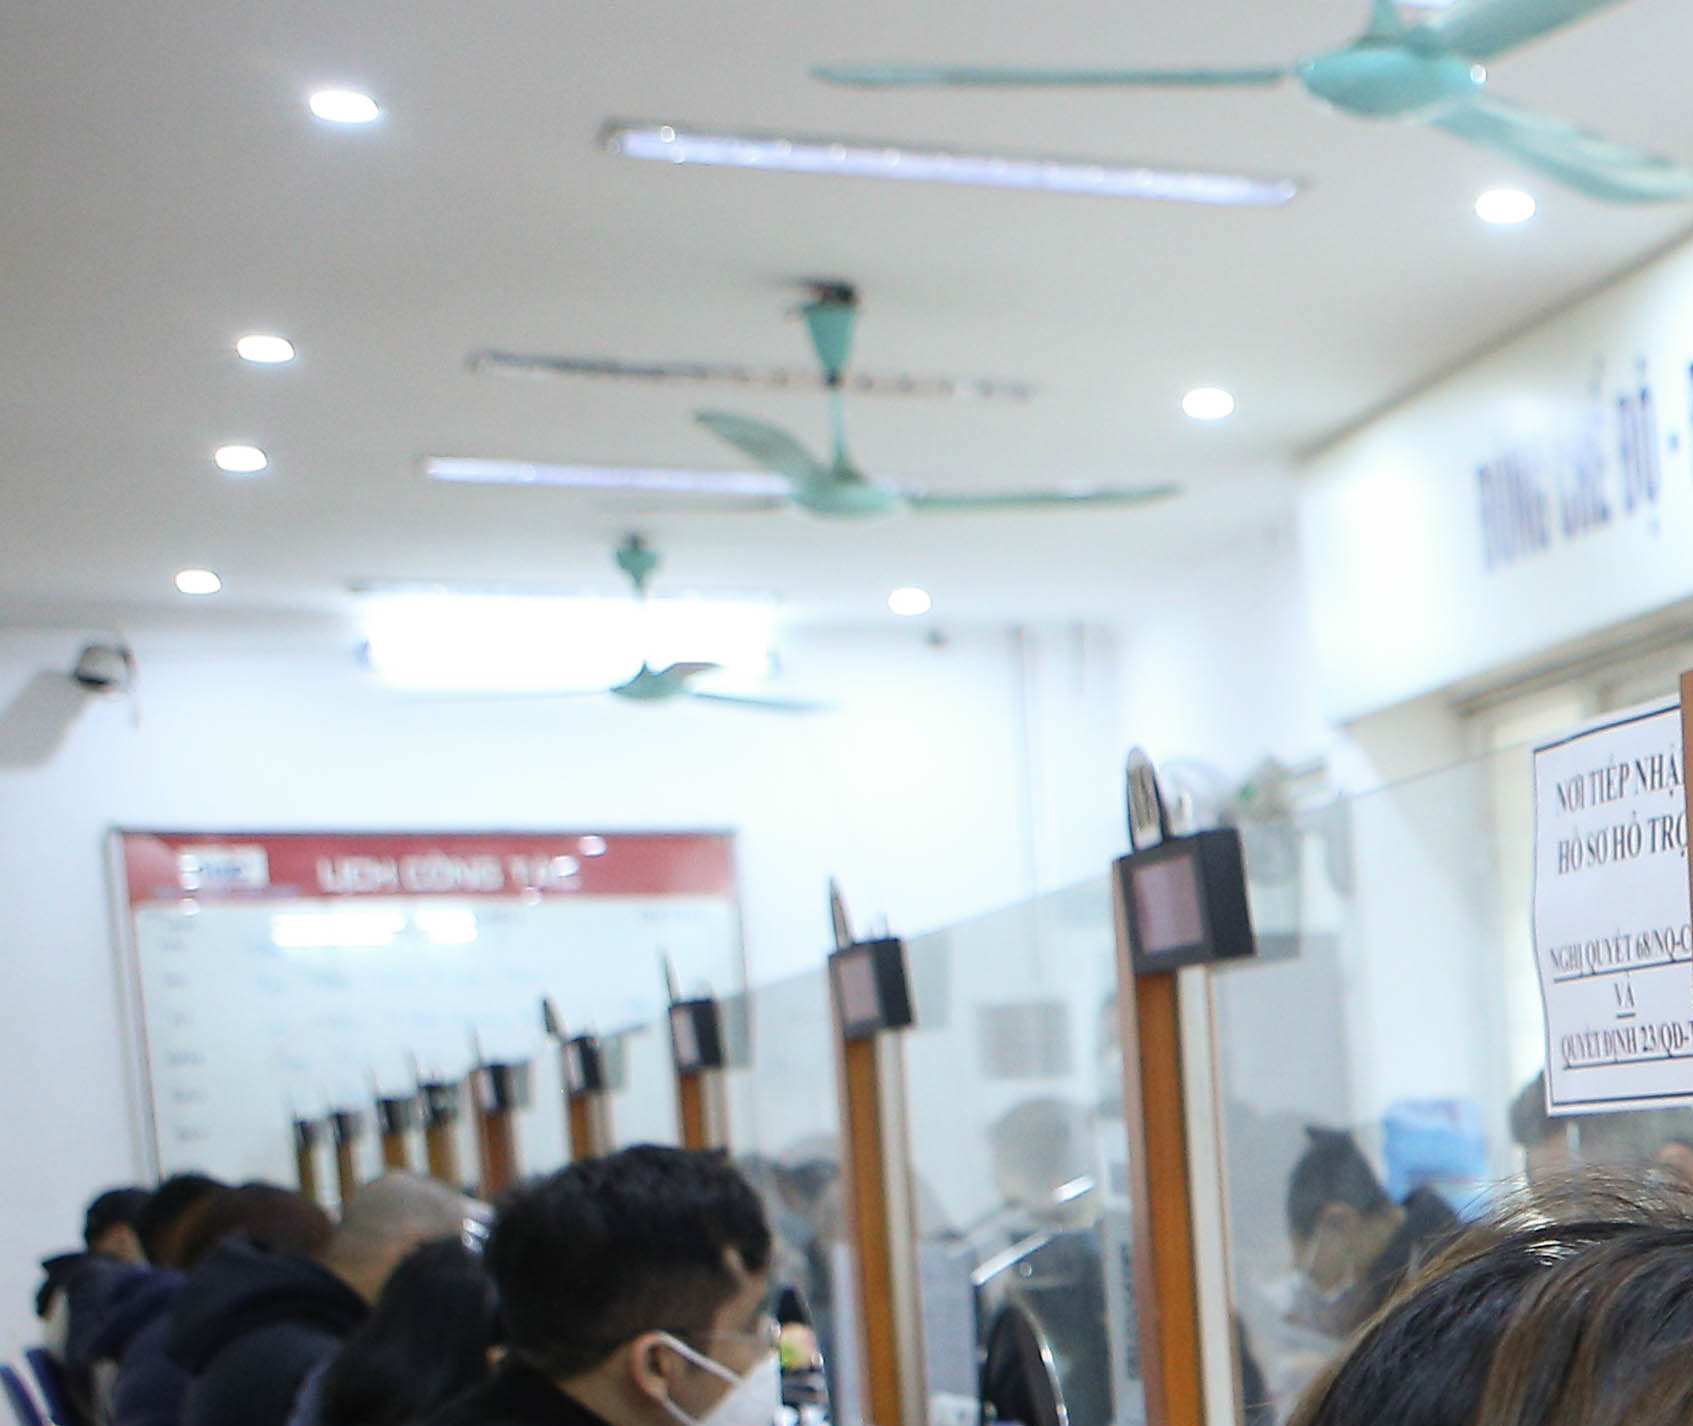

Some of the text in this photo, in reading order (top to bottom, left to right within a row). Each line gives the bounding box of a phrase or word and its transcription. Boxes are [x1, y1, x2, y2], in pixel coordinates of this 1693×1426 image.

[1588, 752, 1631, 807] TIẾP
[1635, 743, 1686, 798] NHẬ
[1635, 923, 1693, 963] 68/NQ-C
[1613, 970, 1637, 1008] VÀ
